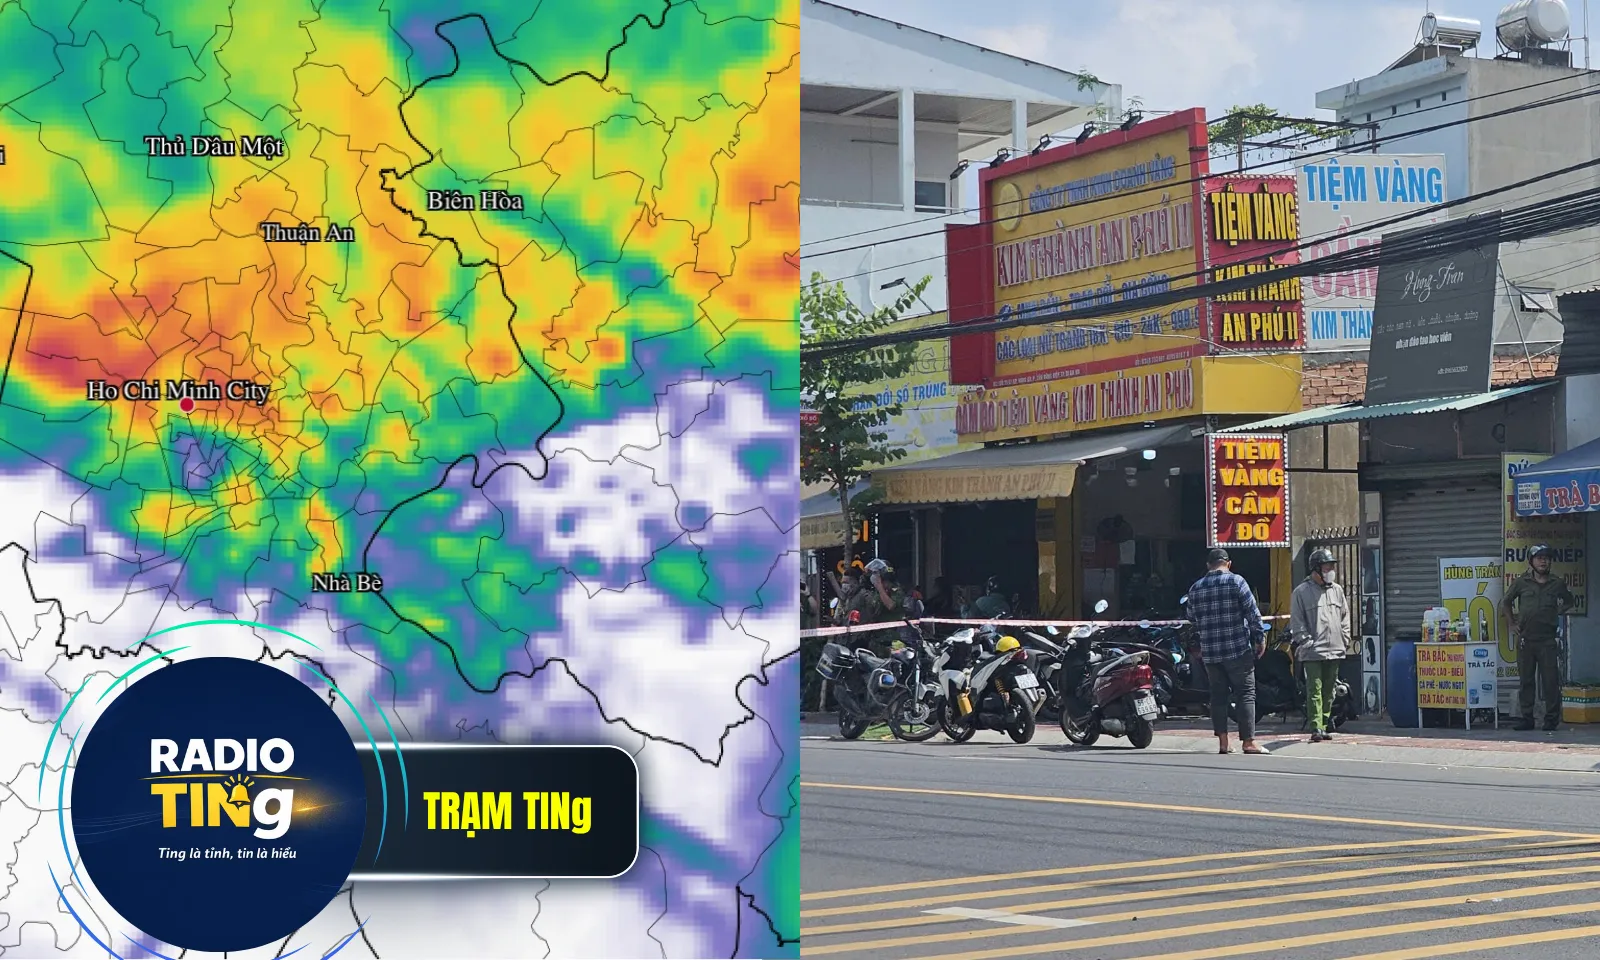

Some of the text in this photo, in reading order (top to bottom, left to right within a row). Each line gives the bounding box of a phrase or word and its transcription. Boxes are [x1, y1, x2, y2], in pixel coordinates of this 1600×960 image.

[1303, 157, 1443, 211] TIỆM VÀNG
[1211, 182, 1297, 246] TIỆM VÀNG
[996, 242, 1032, 287] KIM
[1031, 218, 1097, 280] THÀNH
[1097, 216, 1129, 266] AN
[1130, 192, 1174, 259] PHÚ
[1223, 306, 1299, 342] AN PHÚ II
[1311, 309, 1338, 340] KIM
[995, 336, 1017, 361] CÁC
[896, 382, 909, 405] SỐ
[912, 380, 947, 402] TRÚNG
[999, 388, 1030, 432] TIỆM
[1033, 385, 1068, 423] VÀNG
[1072, 382, 1097, 424] KIM
[1100, 369, 1142, 419] THÀNH
[1143, 372, 1162, 414] AN
[1164, 359, 1194, 411] PHÚ
[1222, 437, 1281, 464] TIỆM
[1220, 463, 1285, 486] VÀNG
[1225, 490, 1281, 515] CẦM
[1545, 479, 1585, 510] TRÀ
[1236, 516, 1270, 541] ĐỒ
[1444, 563, 1473, 580] HÙNG
[1418, 648, 1431, 662] TRÀ
[1420, 692, 1432, 704] TRÀ
